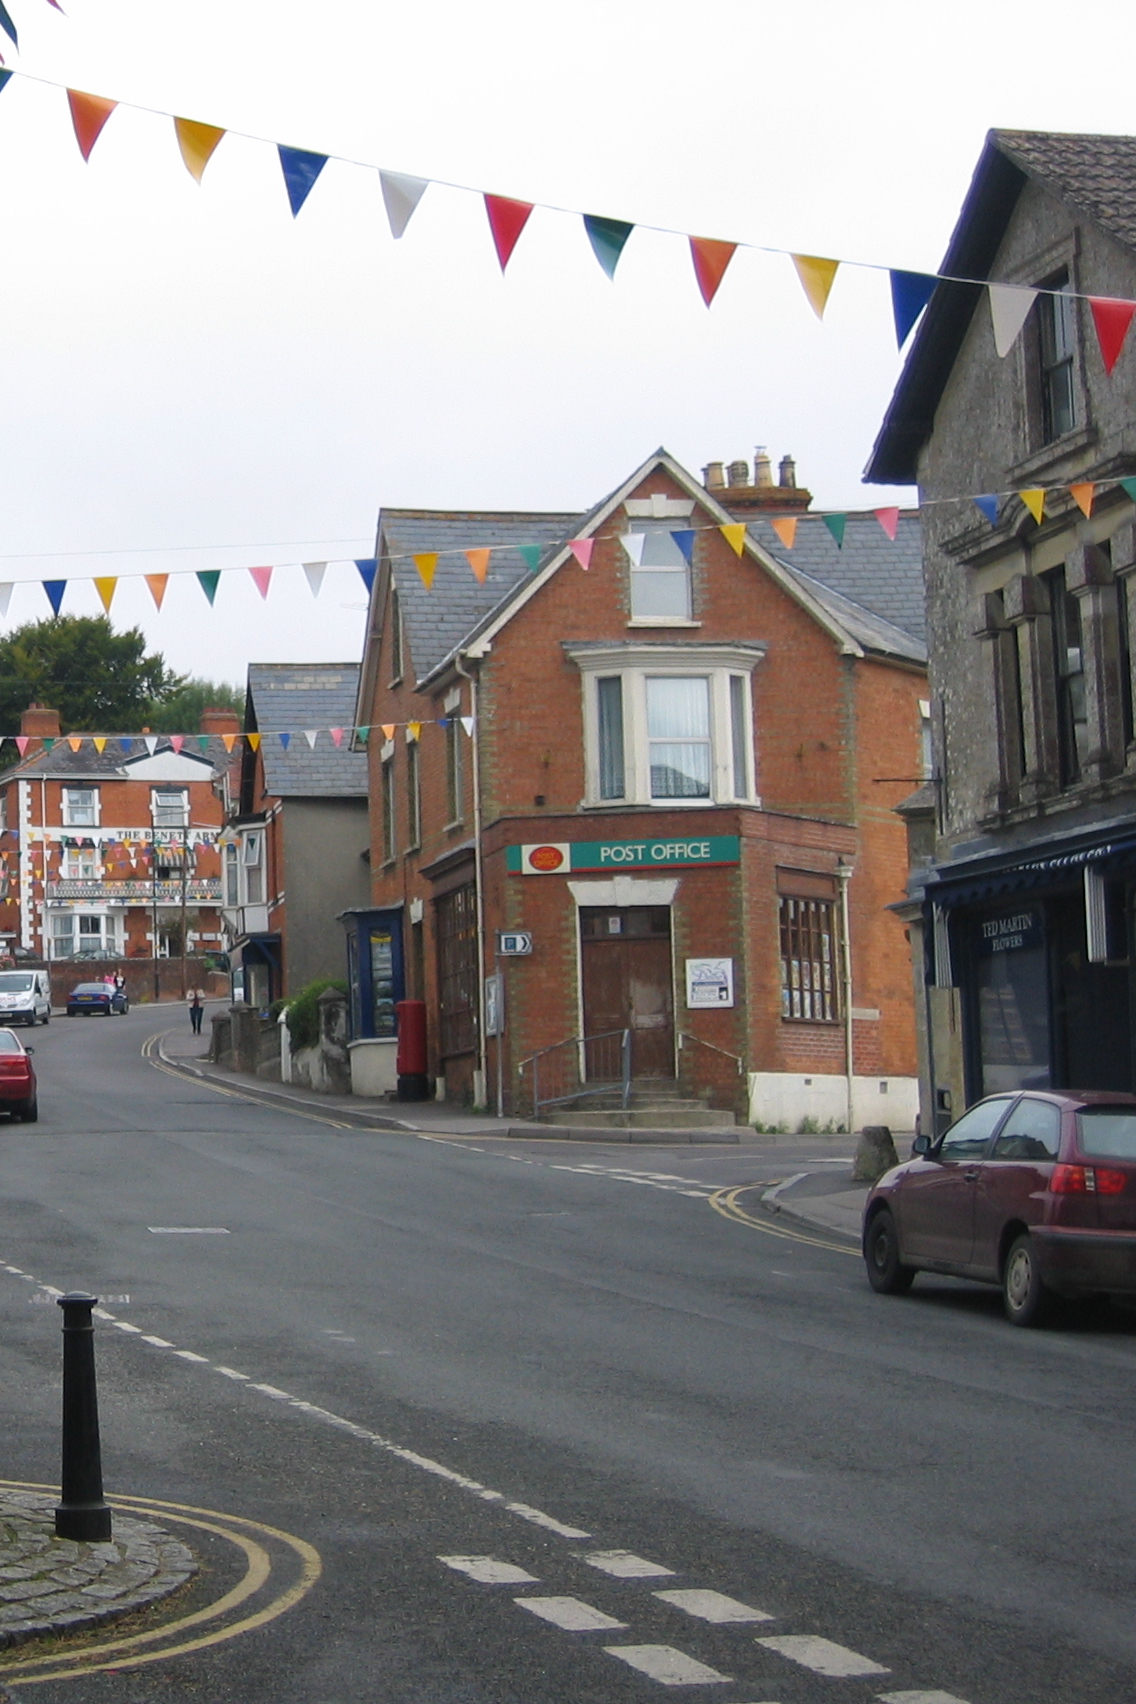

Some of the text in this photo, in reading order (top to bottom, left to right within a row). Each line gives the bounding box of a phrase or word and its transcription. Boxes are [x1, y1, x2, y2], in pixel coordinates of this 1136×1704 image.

[117, 831, 141, 840] THE
[195, 831, 219, 840] ARM
[600, 842, 711, 863] POST OFFICE
[982, 913, 1033, 938] TED MARTIN
[992, 934, 1023, 951] FLOWERS
